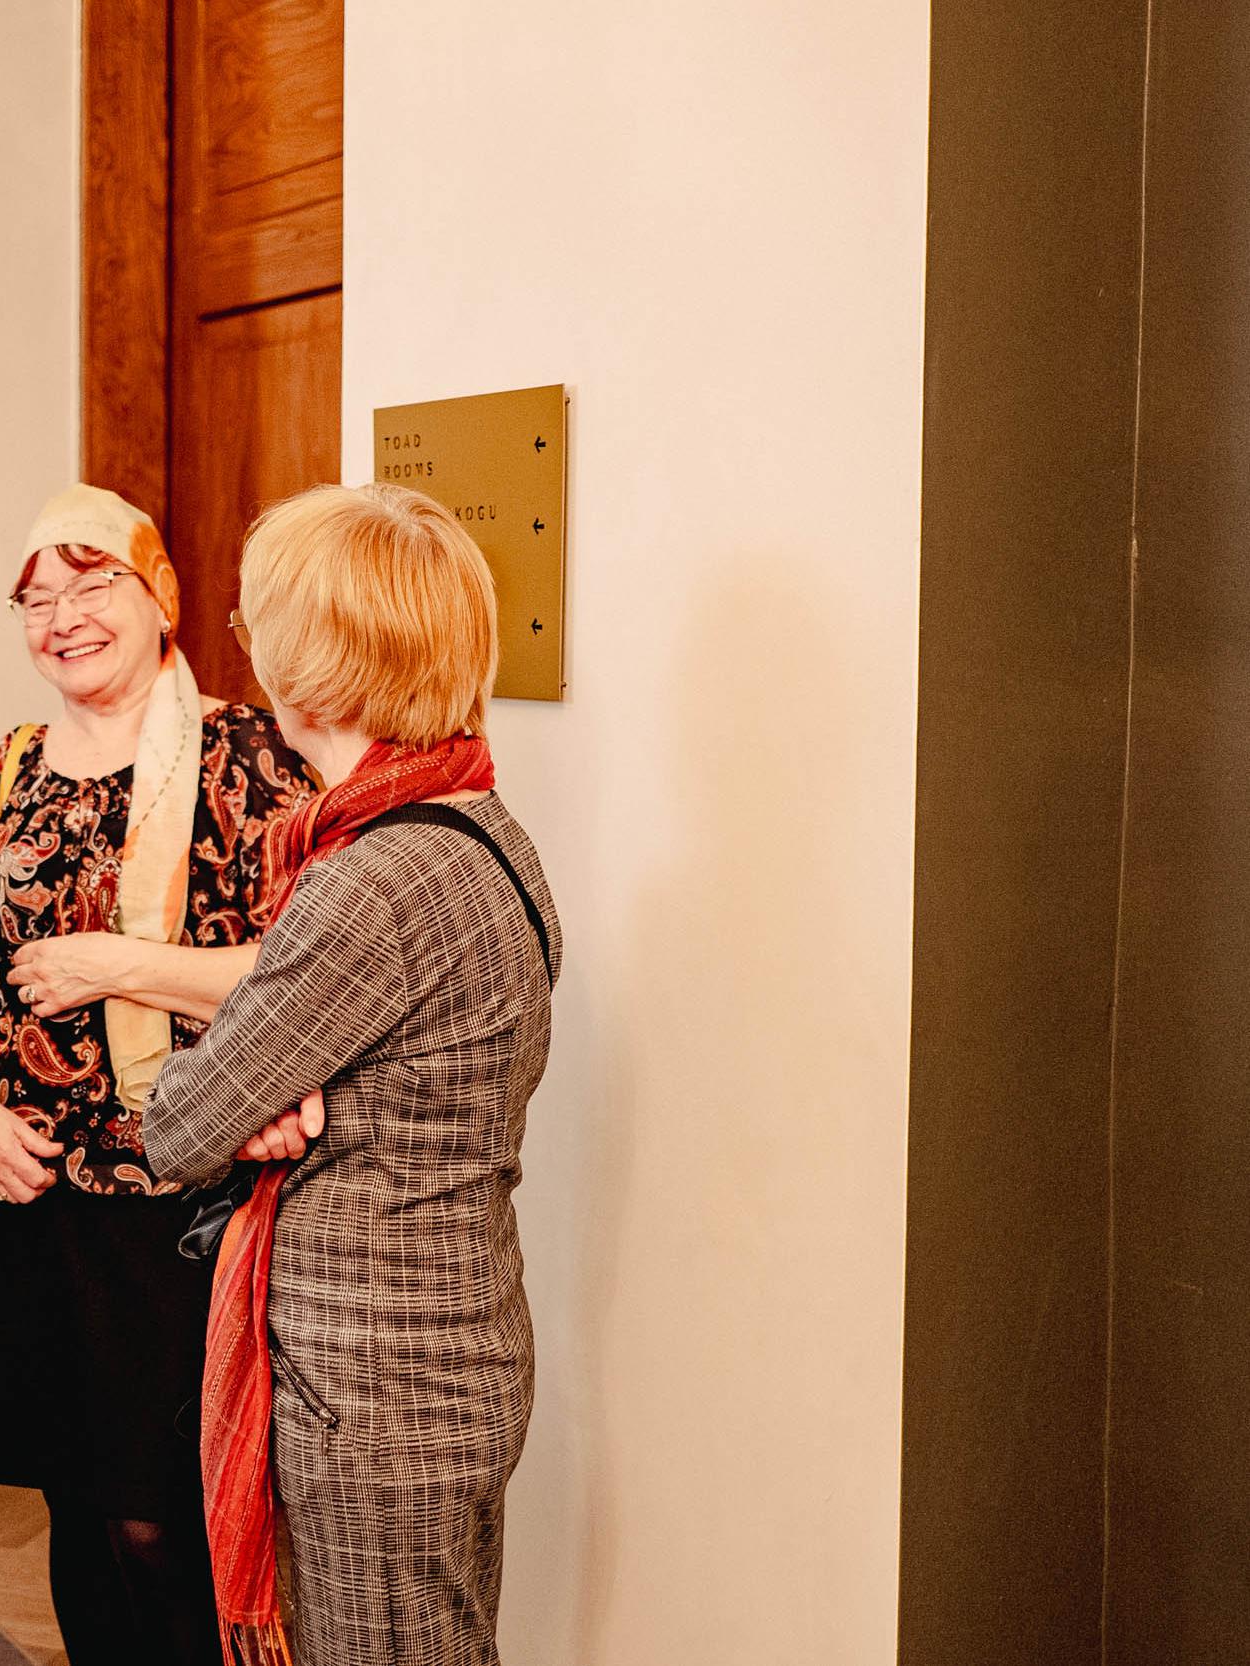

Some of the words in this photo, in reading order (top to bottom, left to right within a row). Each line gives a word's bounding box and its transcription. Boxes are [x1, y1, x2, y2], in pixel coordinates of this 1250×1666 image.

[383, 434, 421, 450] TOAD
[384, 461, 433, 479] ROOMS
[454, 505, 496, 521] KOGU
